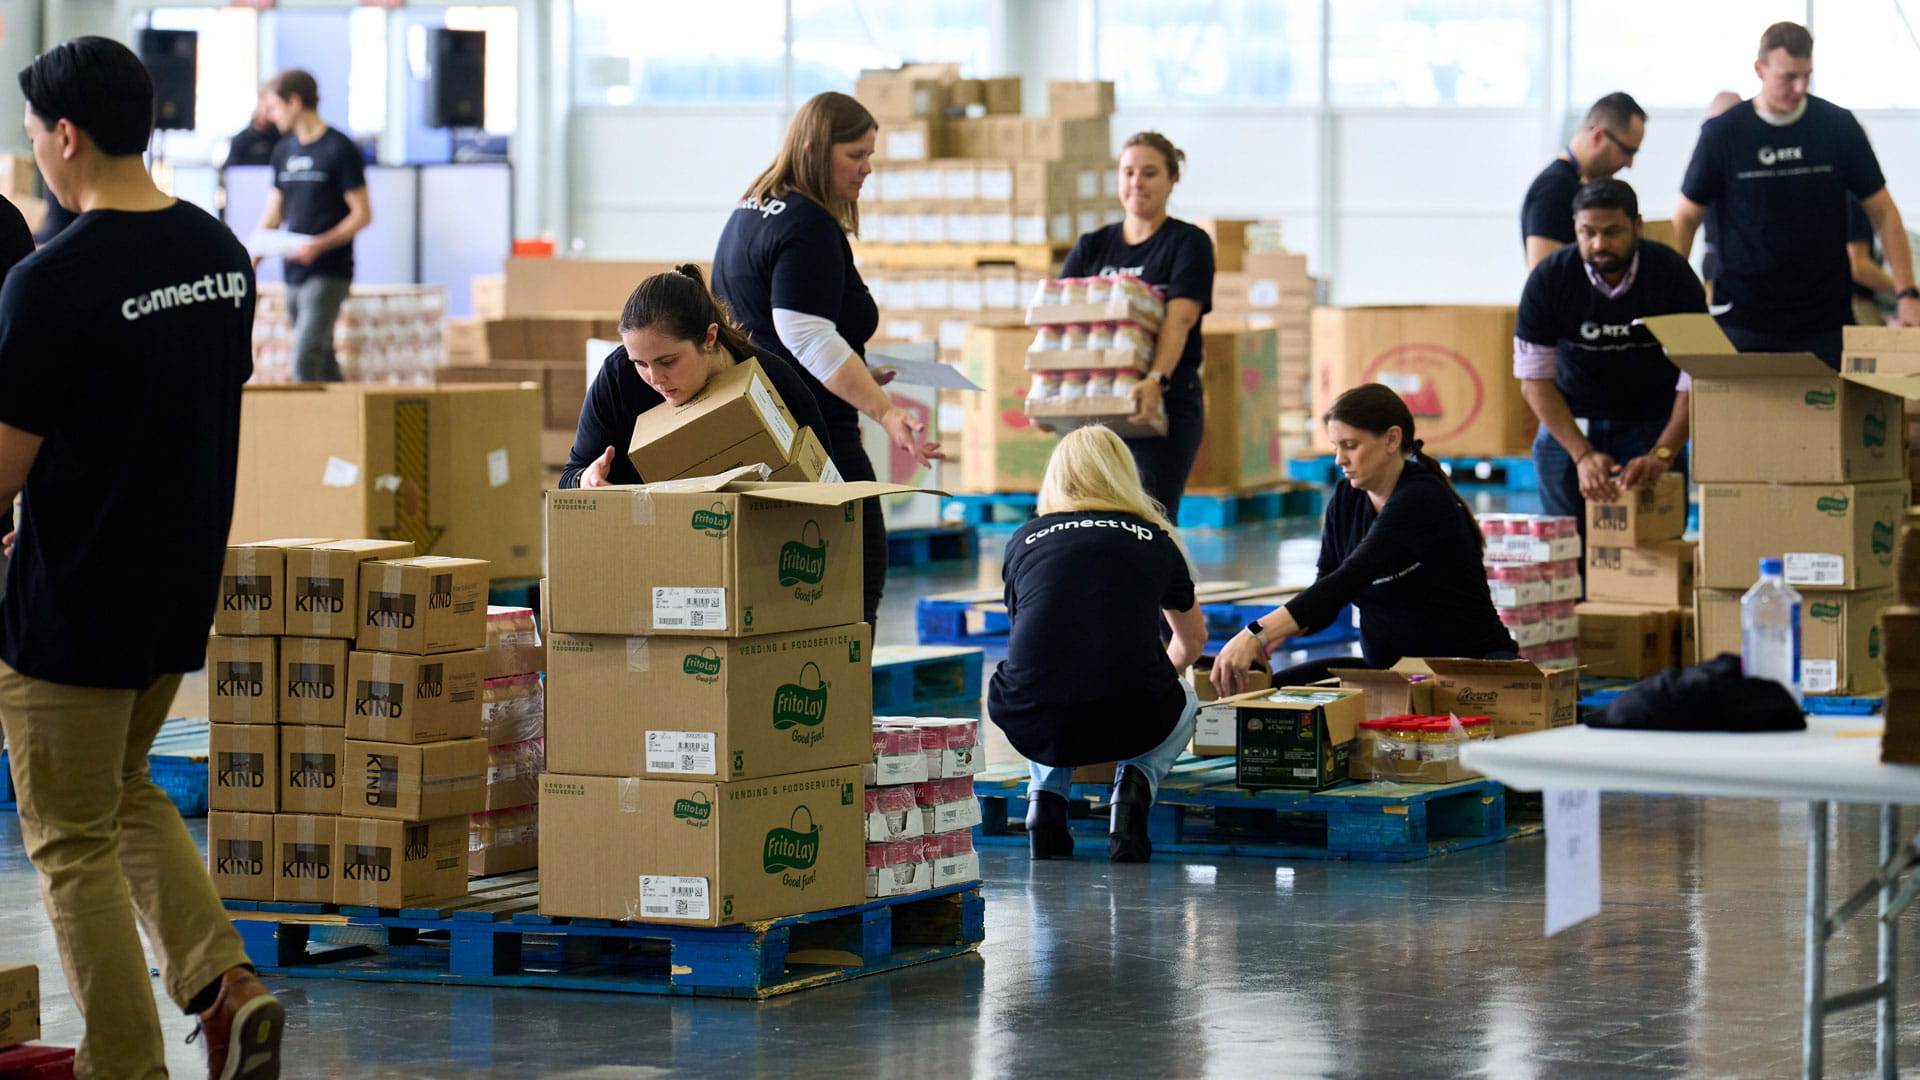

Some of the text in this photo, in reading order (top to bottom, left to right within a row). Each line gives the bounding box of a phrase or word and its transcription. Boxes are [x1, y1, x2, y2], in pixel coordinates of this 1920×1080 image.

[1602, 324, 1631, 336] RTX
[1593, 519, 1627, 531] KIND
[223, 594, 272, 611] KIND
[429, 592, 452, 610] KIND
[794, 587, 810, 602] Good
[295, 595, 344, 613] KIND
[366, 609, 415, 629] KIND
[740, 643, 777, 656] VENDING
[791, 635, 848, 650] FOODSERVICE
[217, 680, 263, 697] KIND
[288, 681, 335, 699] KIND
[417, 680, 443, 699] KIND
[355, 698, 402, 718] KIND
[792, 727, 825, 748] Good fun!
[218, 770, 264, 787] KIND
[290, 770, 336, 788] KIND
[366, 753, 382, 806] KIND
[729, 778, 840, 800] VENDING & FOODSERVICE
[405, 843, 429, 862] KIND
[217, 857, 263, 875] KIND
[282, 860, 330, 879] KIND
[343, 863, 391, 882] KIND
[782, 870, 816, 891] Good fun!
